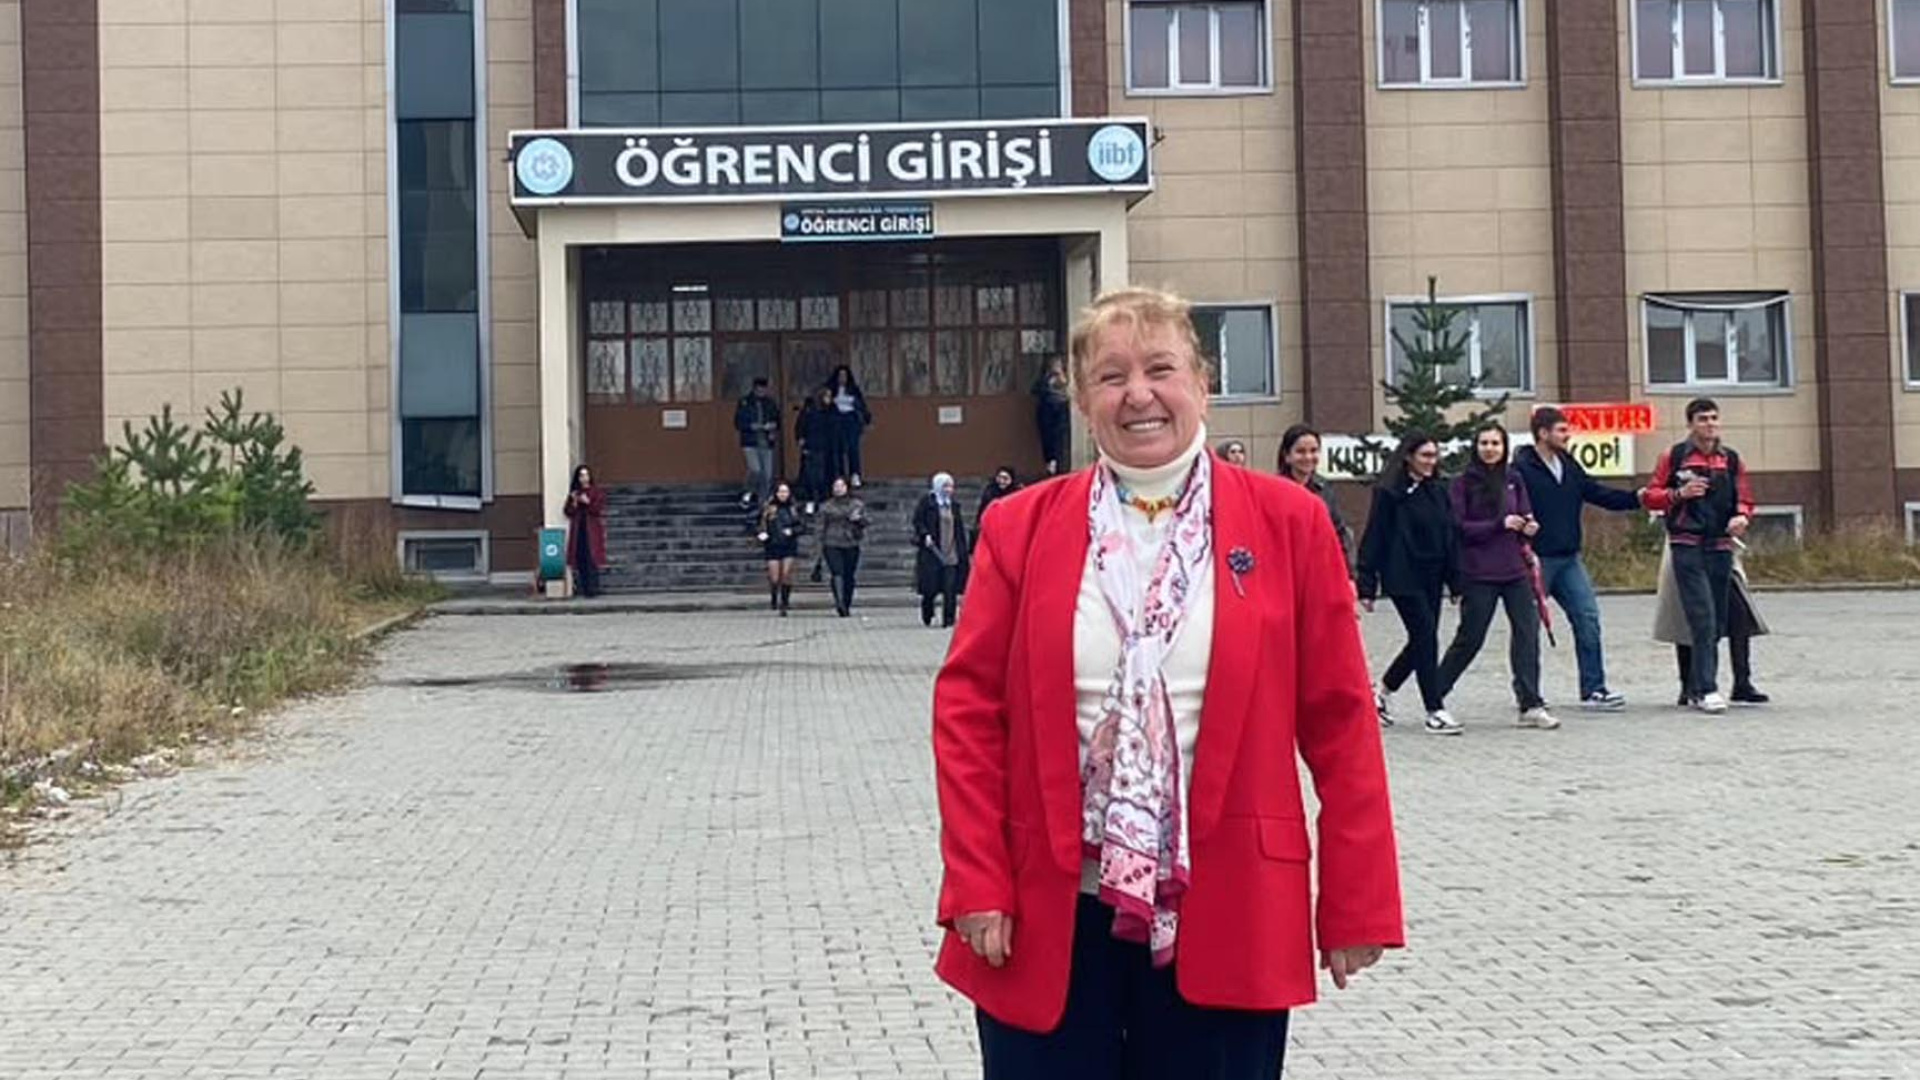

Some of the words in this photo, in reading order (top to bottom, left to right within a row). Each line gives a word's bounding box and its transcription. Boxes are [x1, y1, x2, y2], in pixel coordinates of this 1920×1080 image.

[615, 133, 871, 186] ÖĞRENCİ
[887, 128, 1053, 188] GİRİŞİ
[800, 215, 875, 234] ÖĞRENCİ
[880, 213, 931, 235] GİRİŞİ
